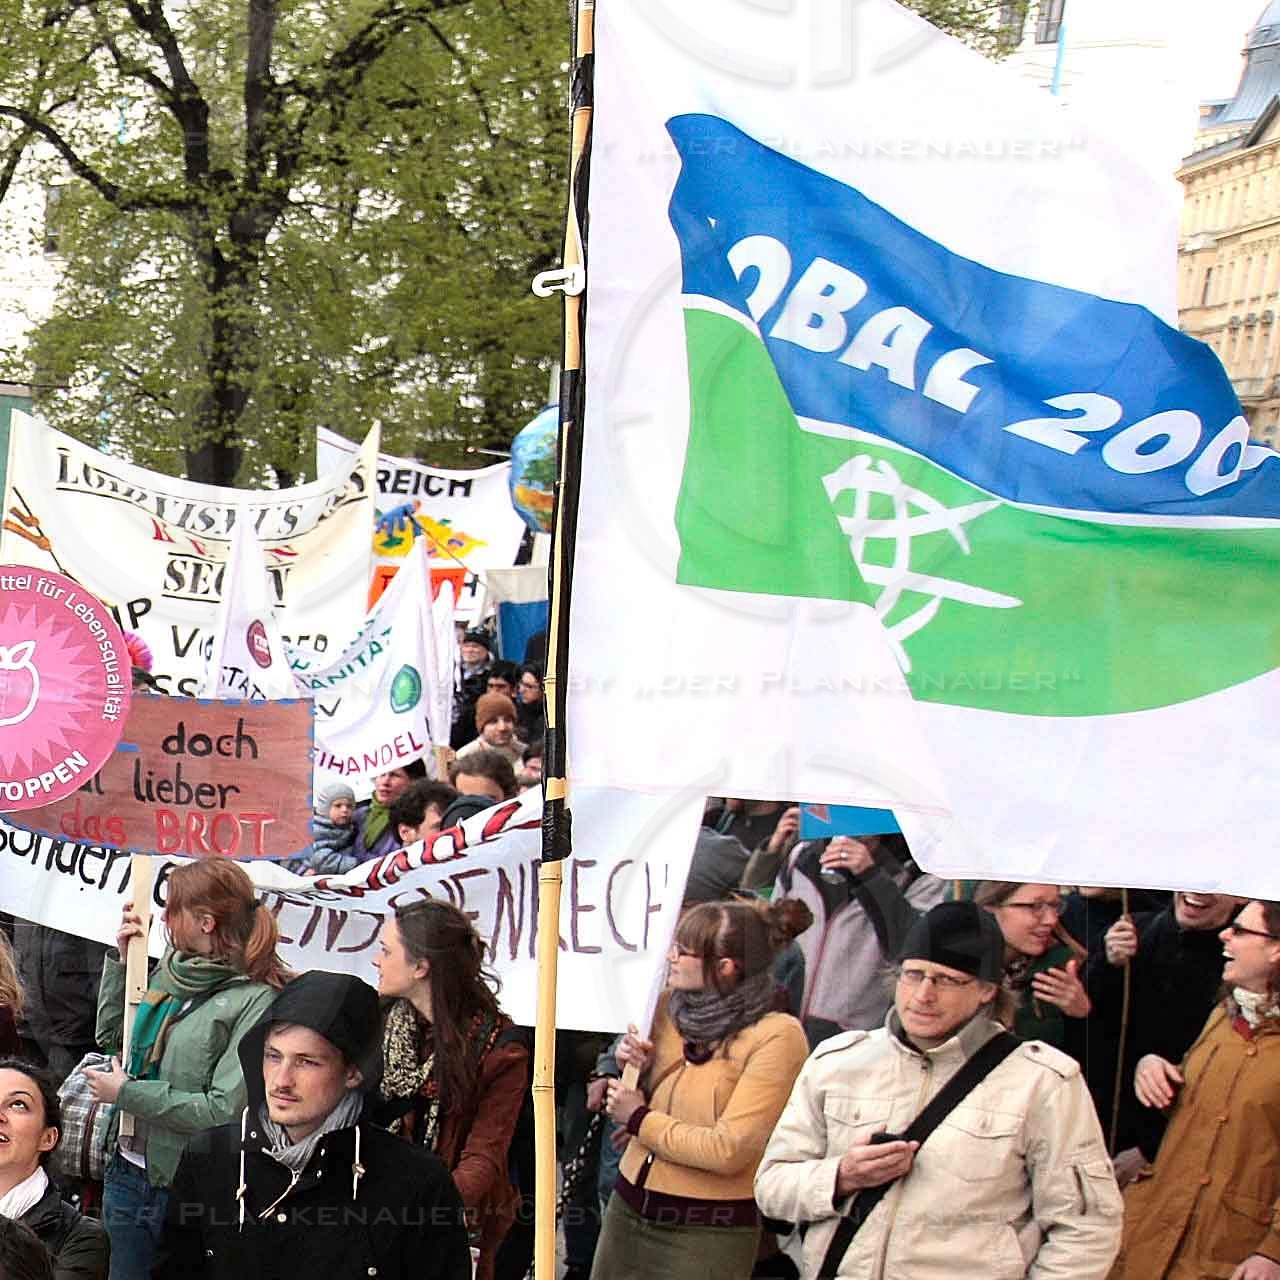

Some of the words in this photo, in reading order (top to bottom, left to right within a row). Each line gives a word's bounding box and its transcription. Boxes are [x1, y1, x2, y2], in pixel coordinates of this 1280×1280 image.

[376, 469, 473, 497] REICH
[36, 577, 67, 600] für
[64, 592, 125, 722] Lebensqualität
[161, 717, 260, 760] doch
[134, 757, 240, 812] lieber
[60, 797, 127, 849] das
[156, 808, 276, 858] BROT
